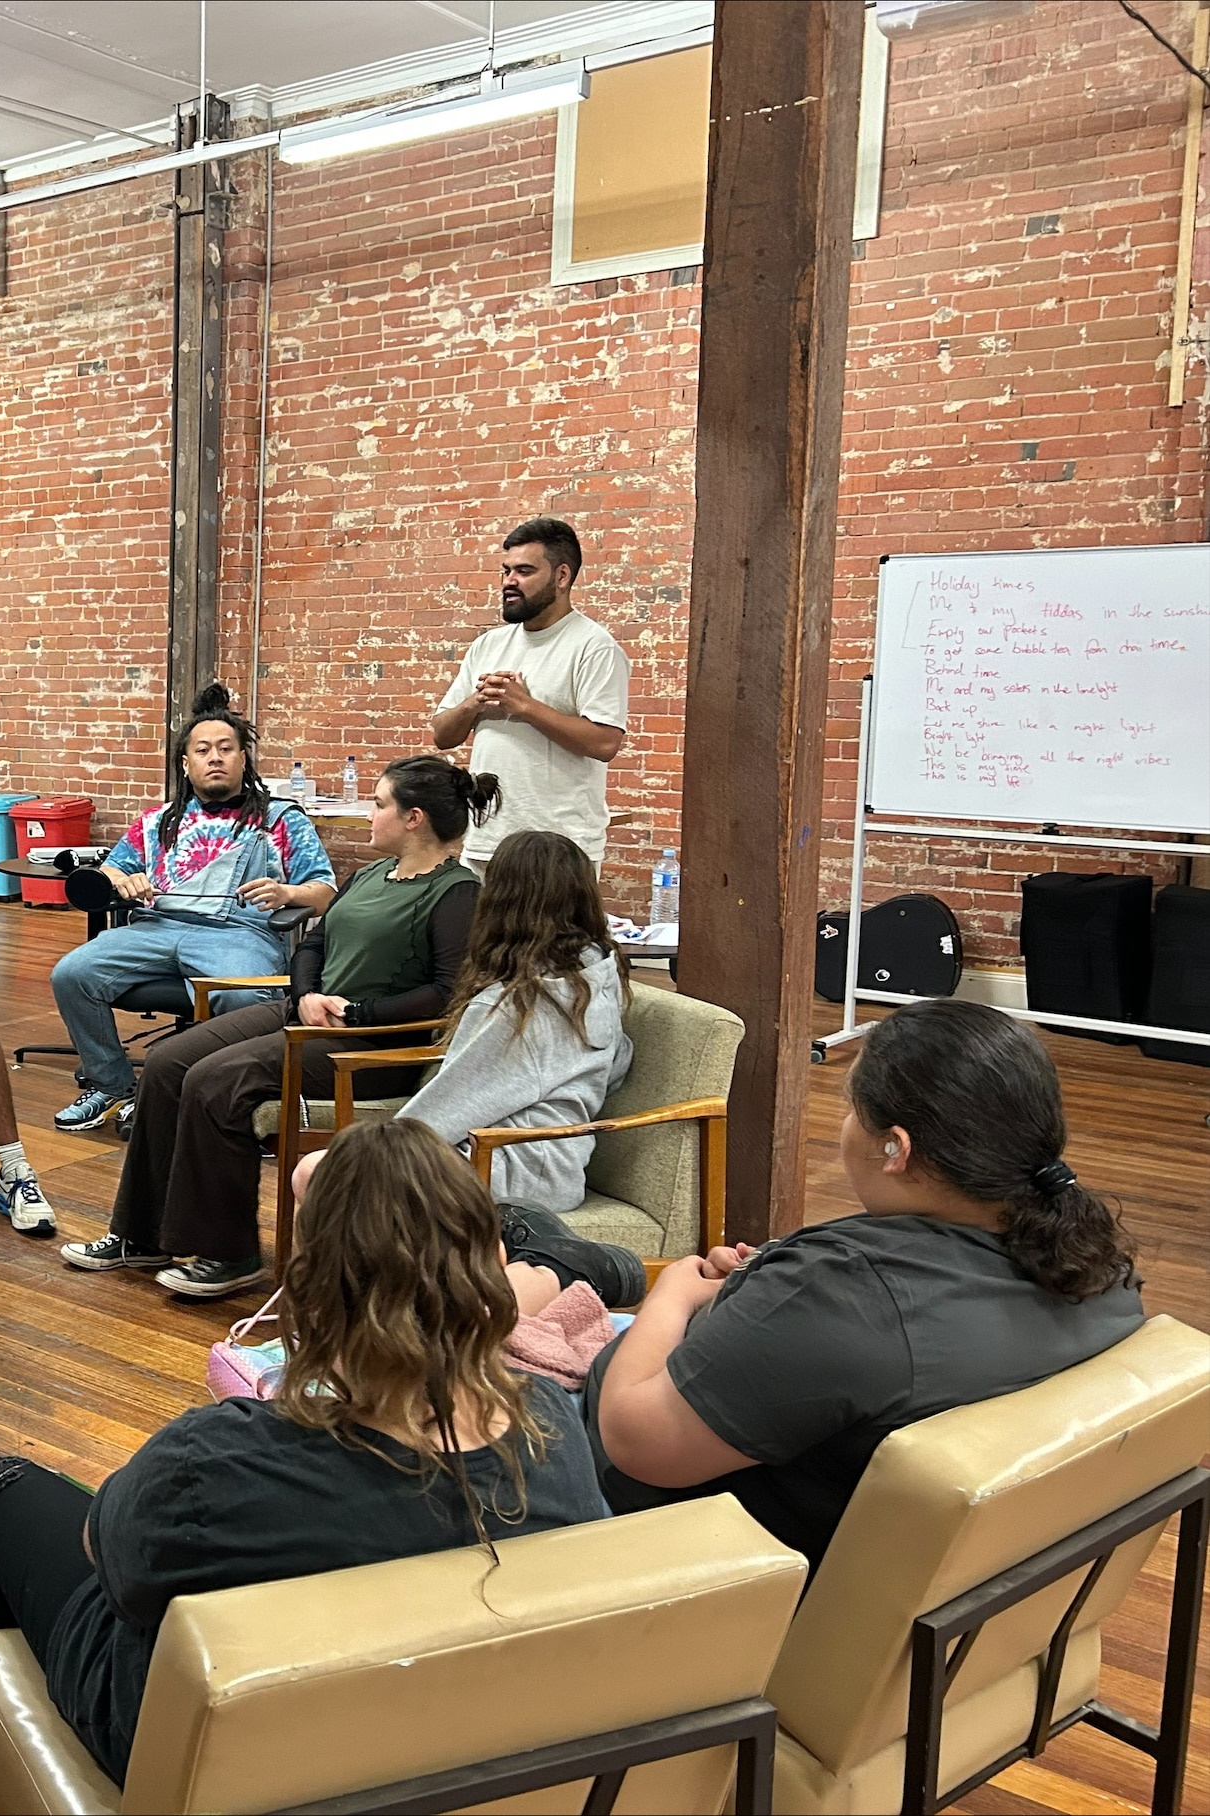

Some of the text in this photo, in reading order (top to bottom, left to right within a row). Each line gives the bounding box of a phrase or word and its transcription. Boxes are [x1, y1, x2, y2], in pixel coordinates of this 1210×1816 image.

[930, 571, 1035, 599] Holiday times
[930, 595, 952, 611] Me
[992, 607, 1016, 626] my
[1102, 606, 1117, 619] in
[1128, 603, 1152, 618] the
[927, 619, 1047, 645] Empty our pockets
[920, 644, 935, 655] To
[944, 646, 962, 661] get
[975, 646, 1003, 655] some
[1012, 642, 1046, 654] bubble
[1051, 642, 1071, 656] tea
[972, 664, 1001, 678] time
[926, 677, 943, 694] Me
[954, 682, 973, 695] and
[980, 686, 995, 701] my
[1054, 683, 1072, 694] the
[926, 697, 977, 717] Back up
[1018, 718, 1038, 730] like
[1119, 718, 1156, 739] light
[924, 743, 942, 756] We
[955, 743, 969, 758] be
[1040, 750, 1056, 762] all
[1066, 751, 1085, 762] the
[1135, 752, 1170, 765] vibes
[920, 757, 1030, 776] This is my time
[956, 772, 966, 781] is
[979, 774, 996, 787] my
